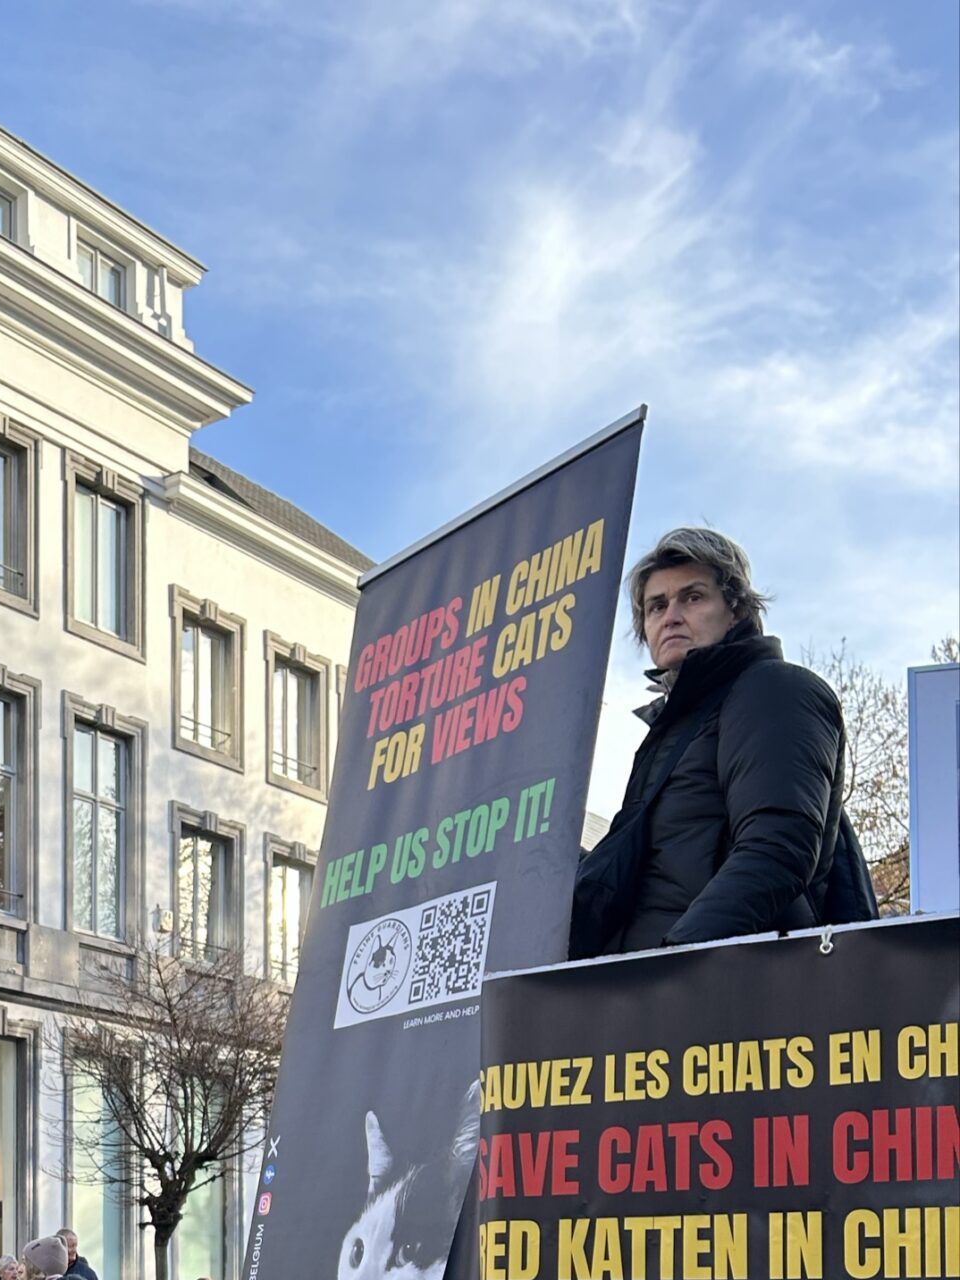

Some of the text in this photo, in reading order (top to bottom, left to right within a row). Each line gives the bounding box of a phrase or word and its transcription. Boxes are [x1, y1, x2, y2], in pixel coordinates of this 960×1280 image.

[354, 518, 605, 693] GROUPS IN CHINA
[367, 593, 576, 739] TORTURE CATS
[367, 676, 527, 791] FOR VIEWS
[320, 777, 556, 909] HELP US STOP IT!
[403, 1005, 480, 1029] LEARN MORE AND HELP
[604, 1049, 670, 1103] LES
[682, 1036, 815, 1097] CHATS
[829, 1029, 881, 1086] EN
[598, 1119, 733, 1194] CATS
[753, 1115, 809, 1188] IN
[769, 1211, 823, 1280] IN
